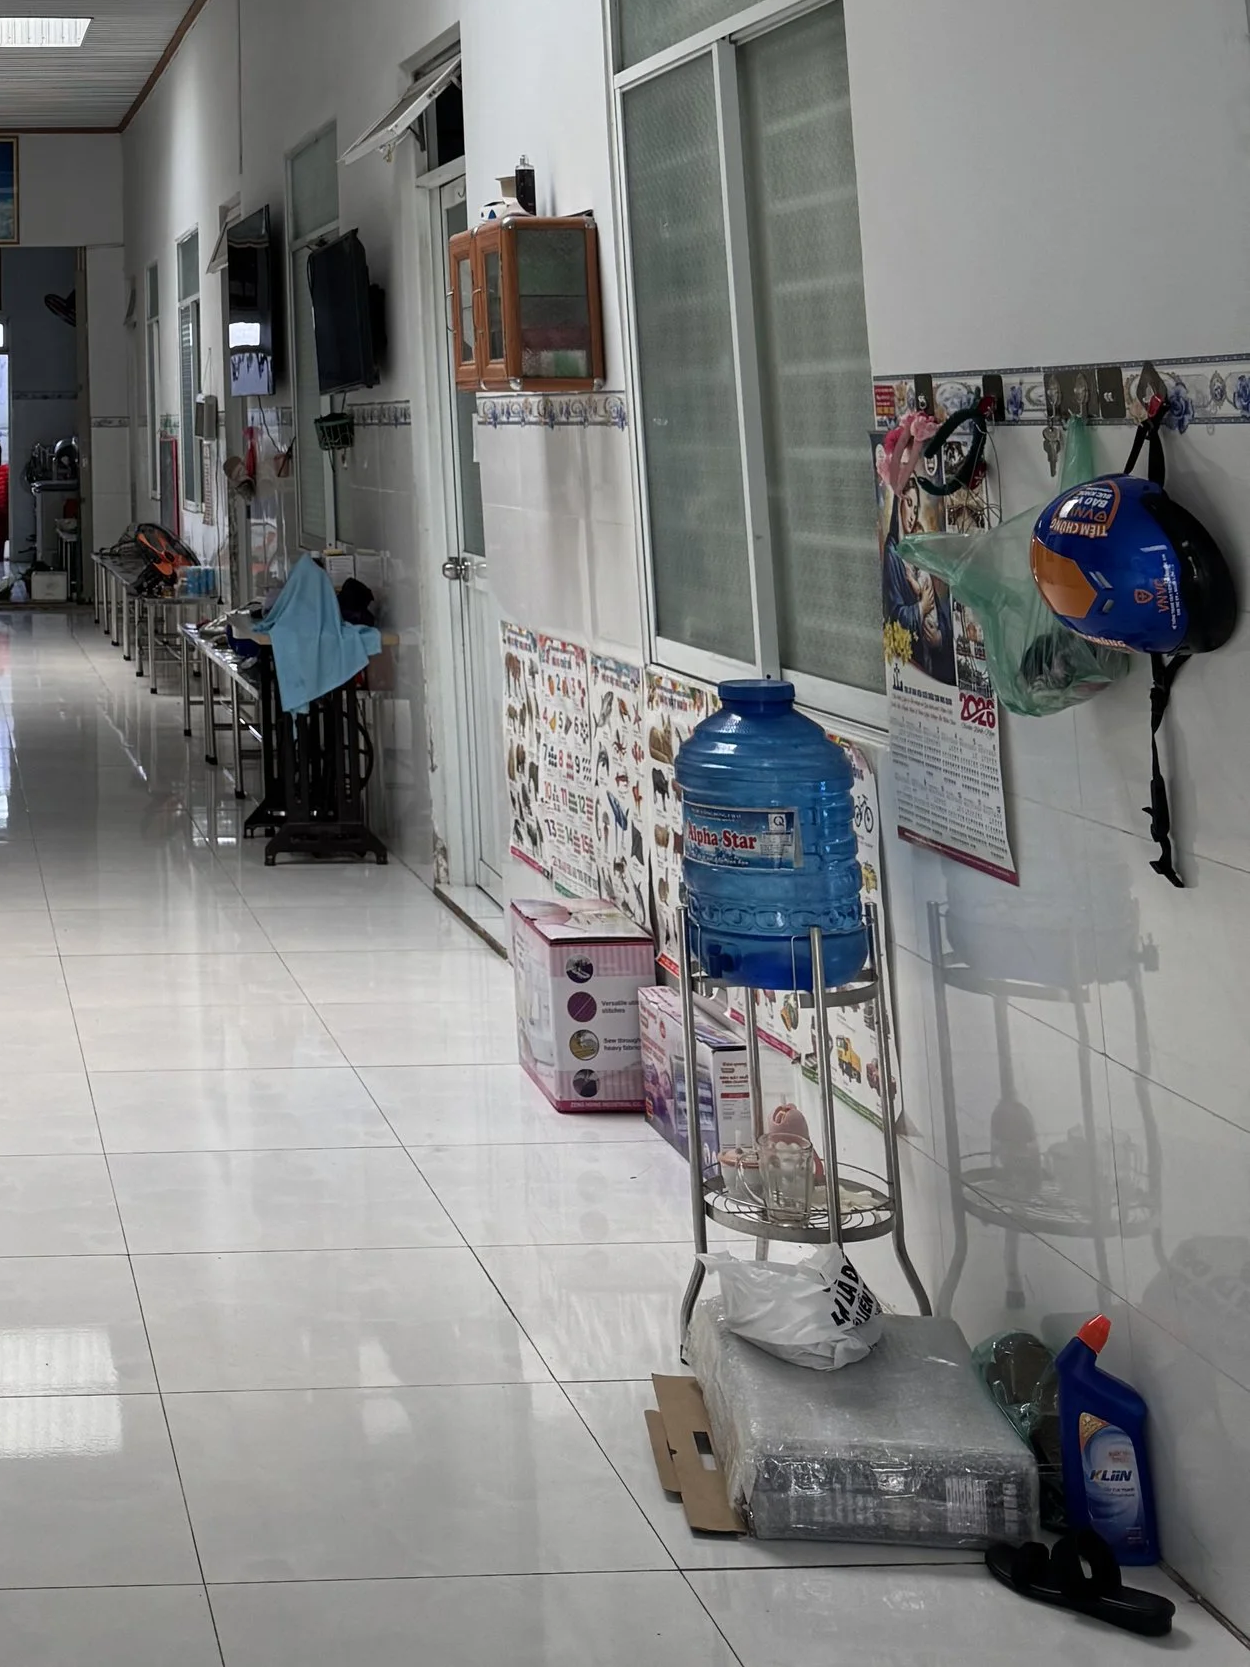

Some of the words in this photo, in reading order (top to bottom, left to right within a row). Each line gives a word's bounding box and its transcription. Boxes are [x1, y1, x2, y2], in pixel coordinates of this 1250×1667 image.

[958, 692, 997, 730] 2026
[686, 818, 719, 847] Alpha
[722, 828, 757, 850] Star
